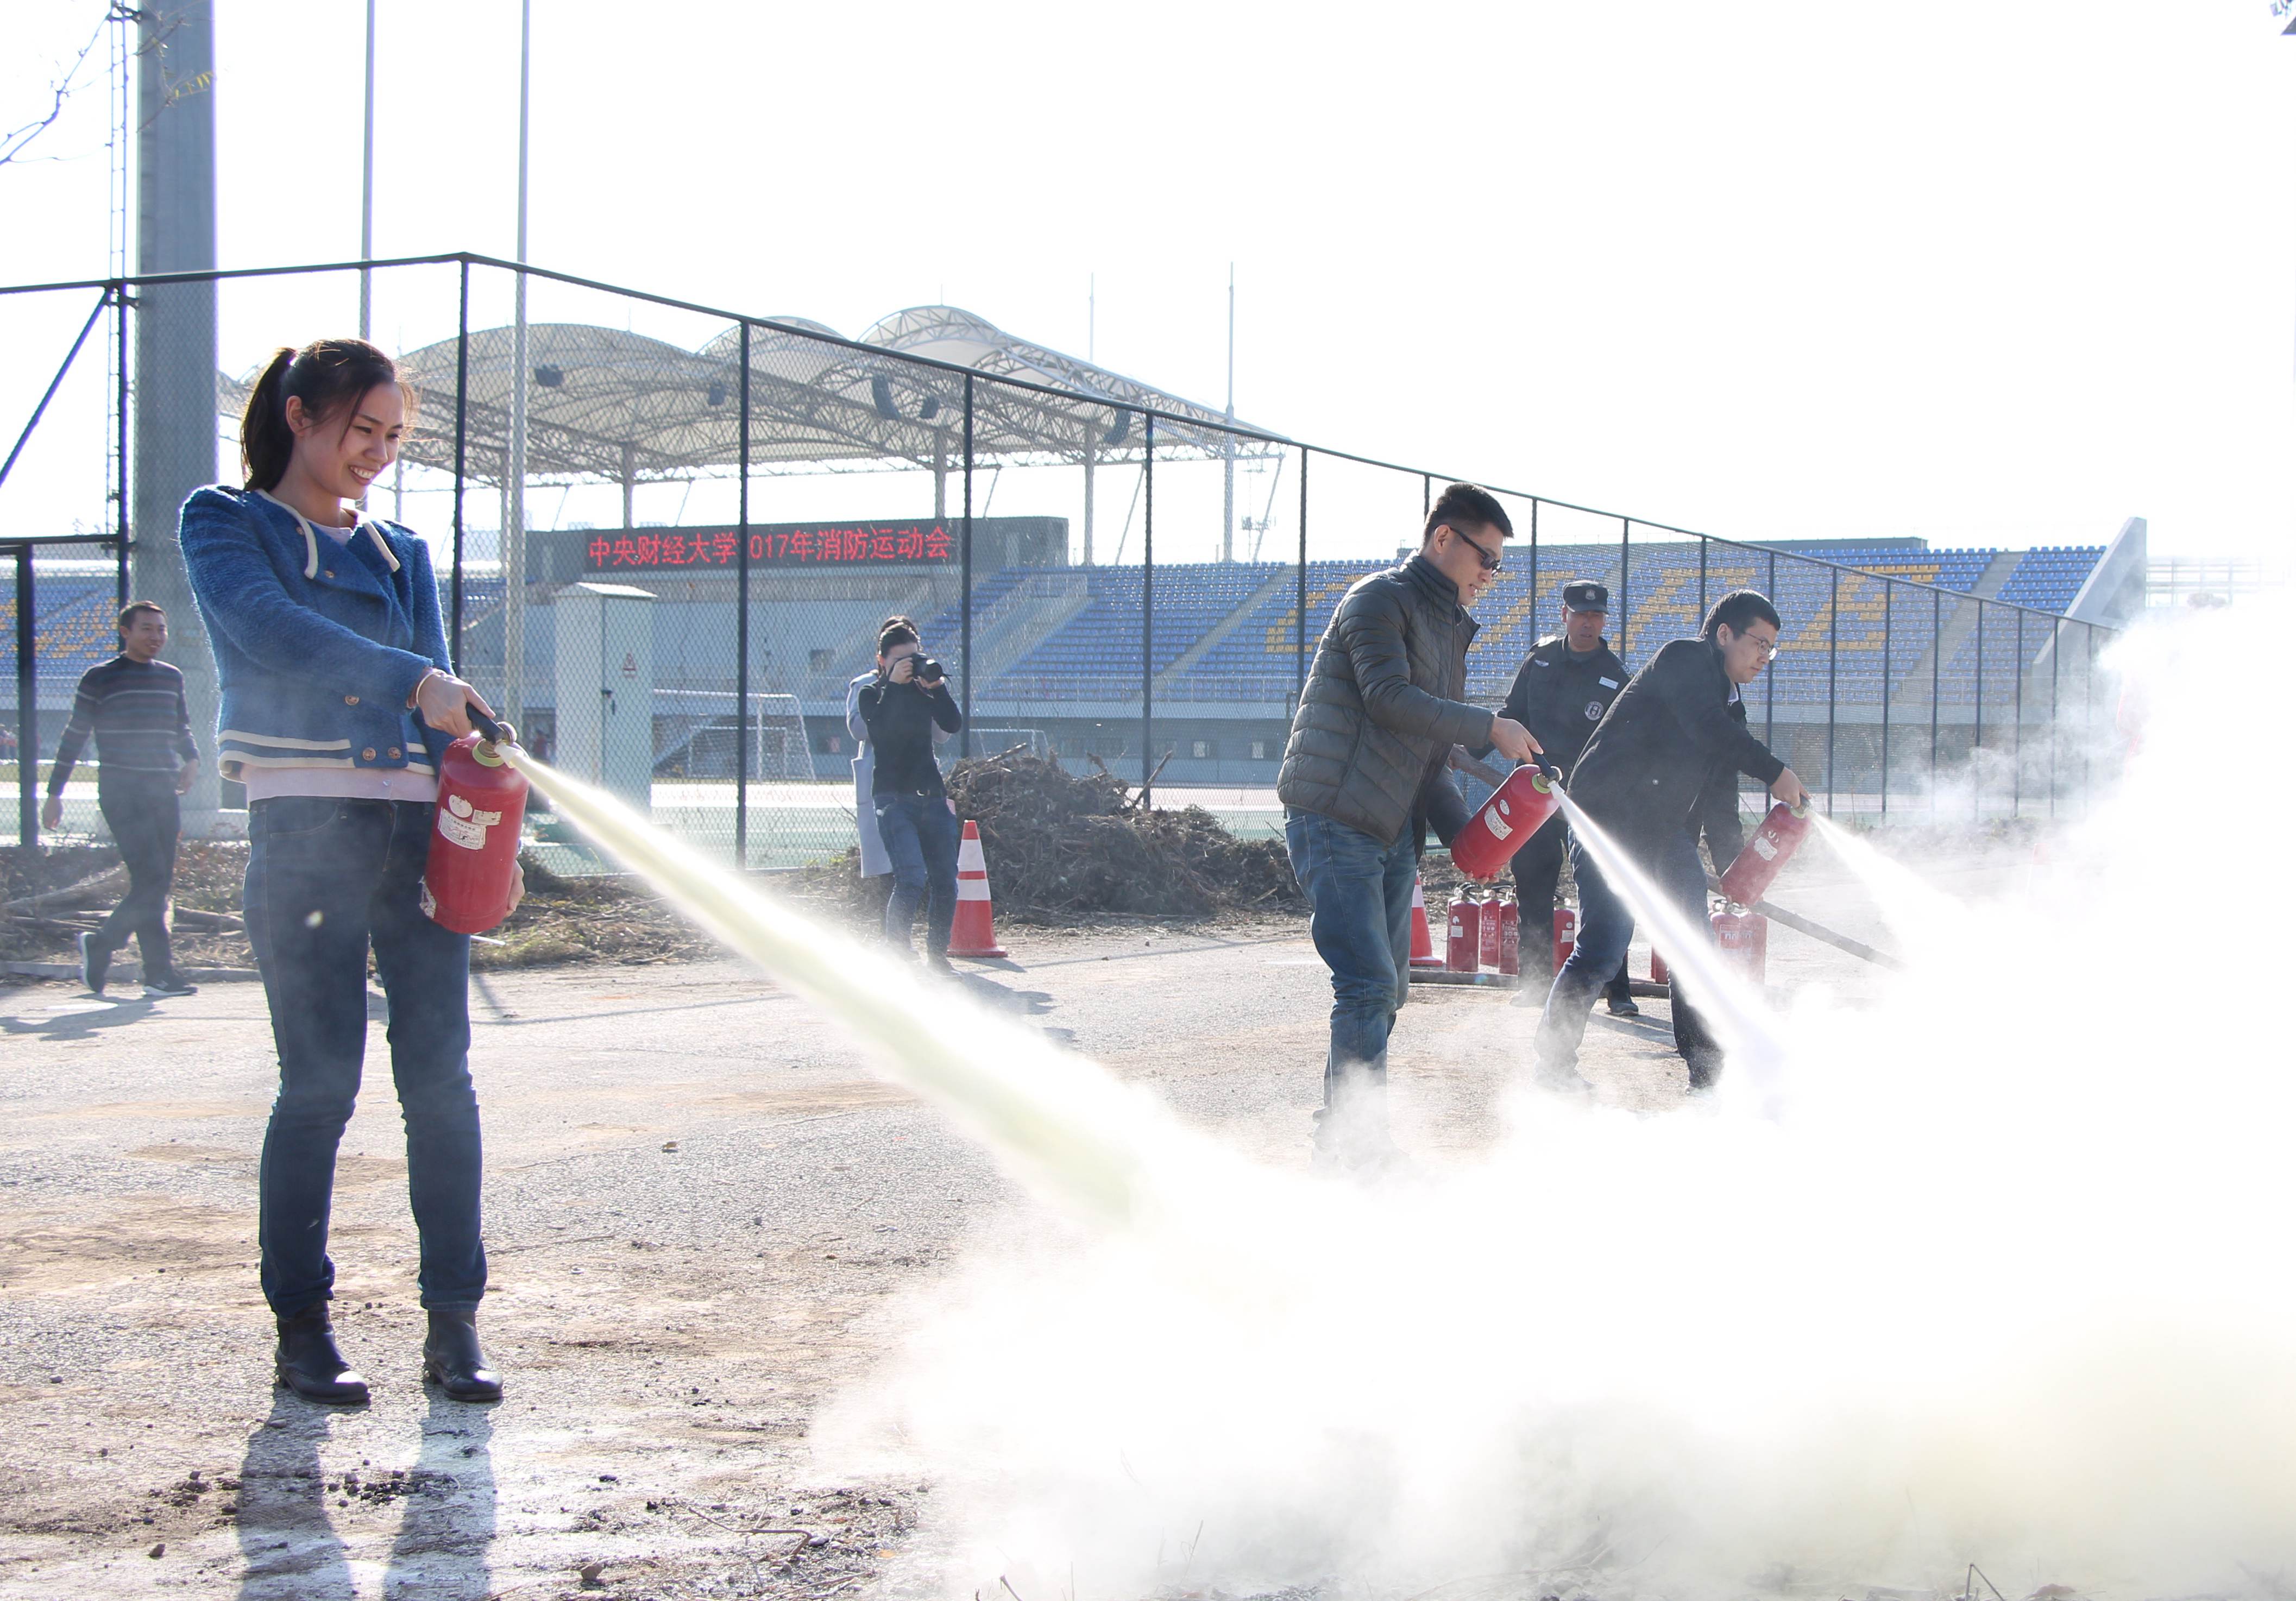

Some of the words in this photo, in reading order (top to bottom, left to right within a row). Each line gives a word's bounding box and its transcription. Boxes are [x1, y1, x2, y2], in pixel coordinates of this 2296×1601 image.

[589, 526, 951, 567] 中央财经大学017年消防运动会
